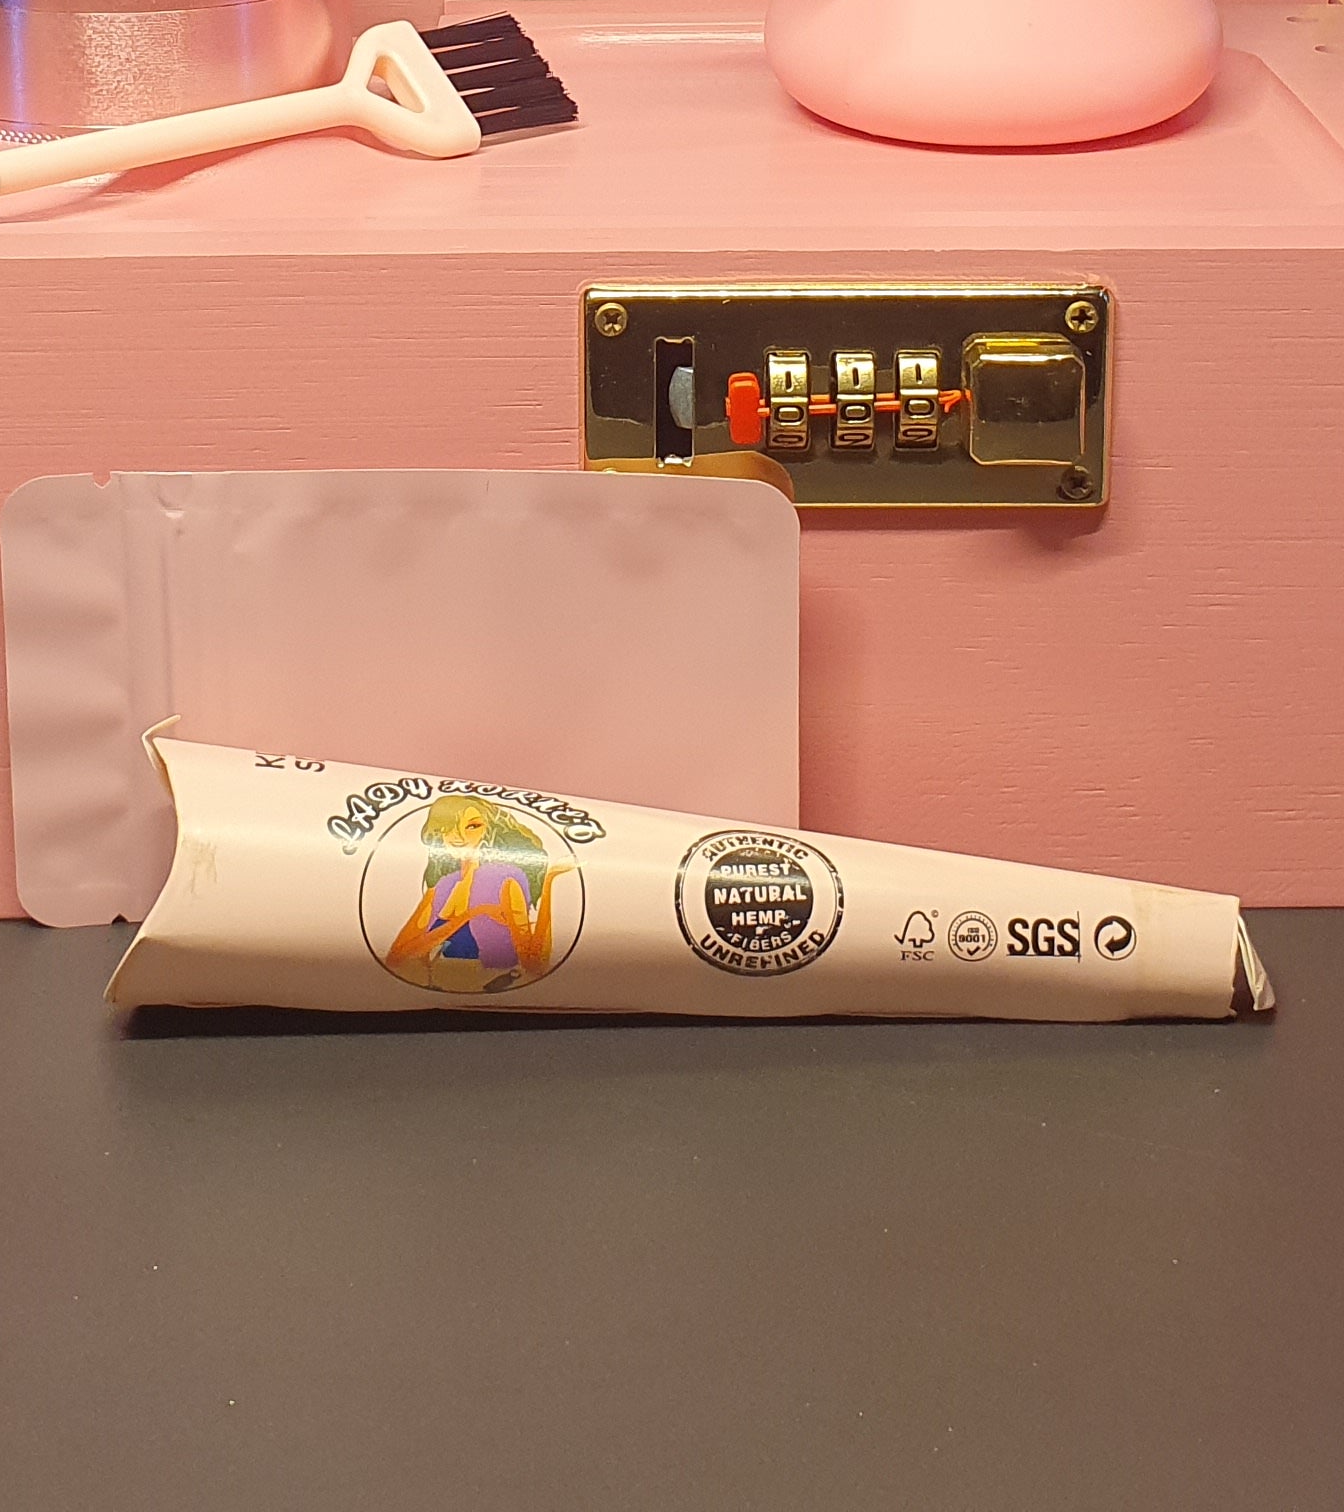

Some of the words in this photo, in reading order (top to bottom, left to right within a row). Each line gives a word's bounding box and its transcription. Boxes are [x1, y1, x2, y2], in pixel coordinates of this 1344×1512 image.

[327, 778, 433, 855] LADY
[702, 835, 809, 862] AUTHENTIC
[720, 863, 791, 877] PUREST
[713, 885, 808, 905] NATURAL
[731, 909, 787, 928] HEMP
[731, 930, 792, 951] FIBERS
[1007, 917, 1080, 956] SGS
[700, 930, 825, 969] UNREFINED
[900, 950, 936, 961] FSC
